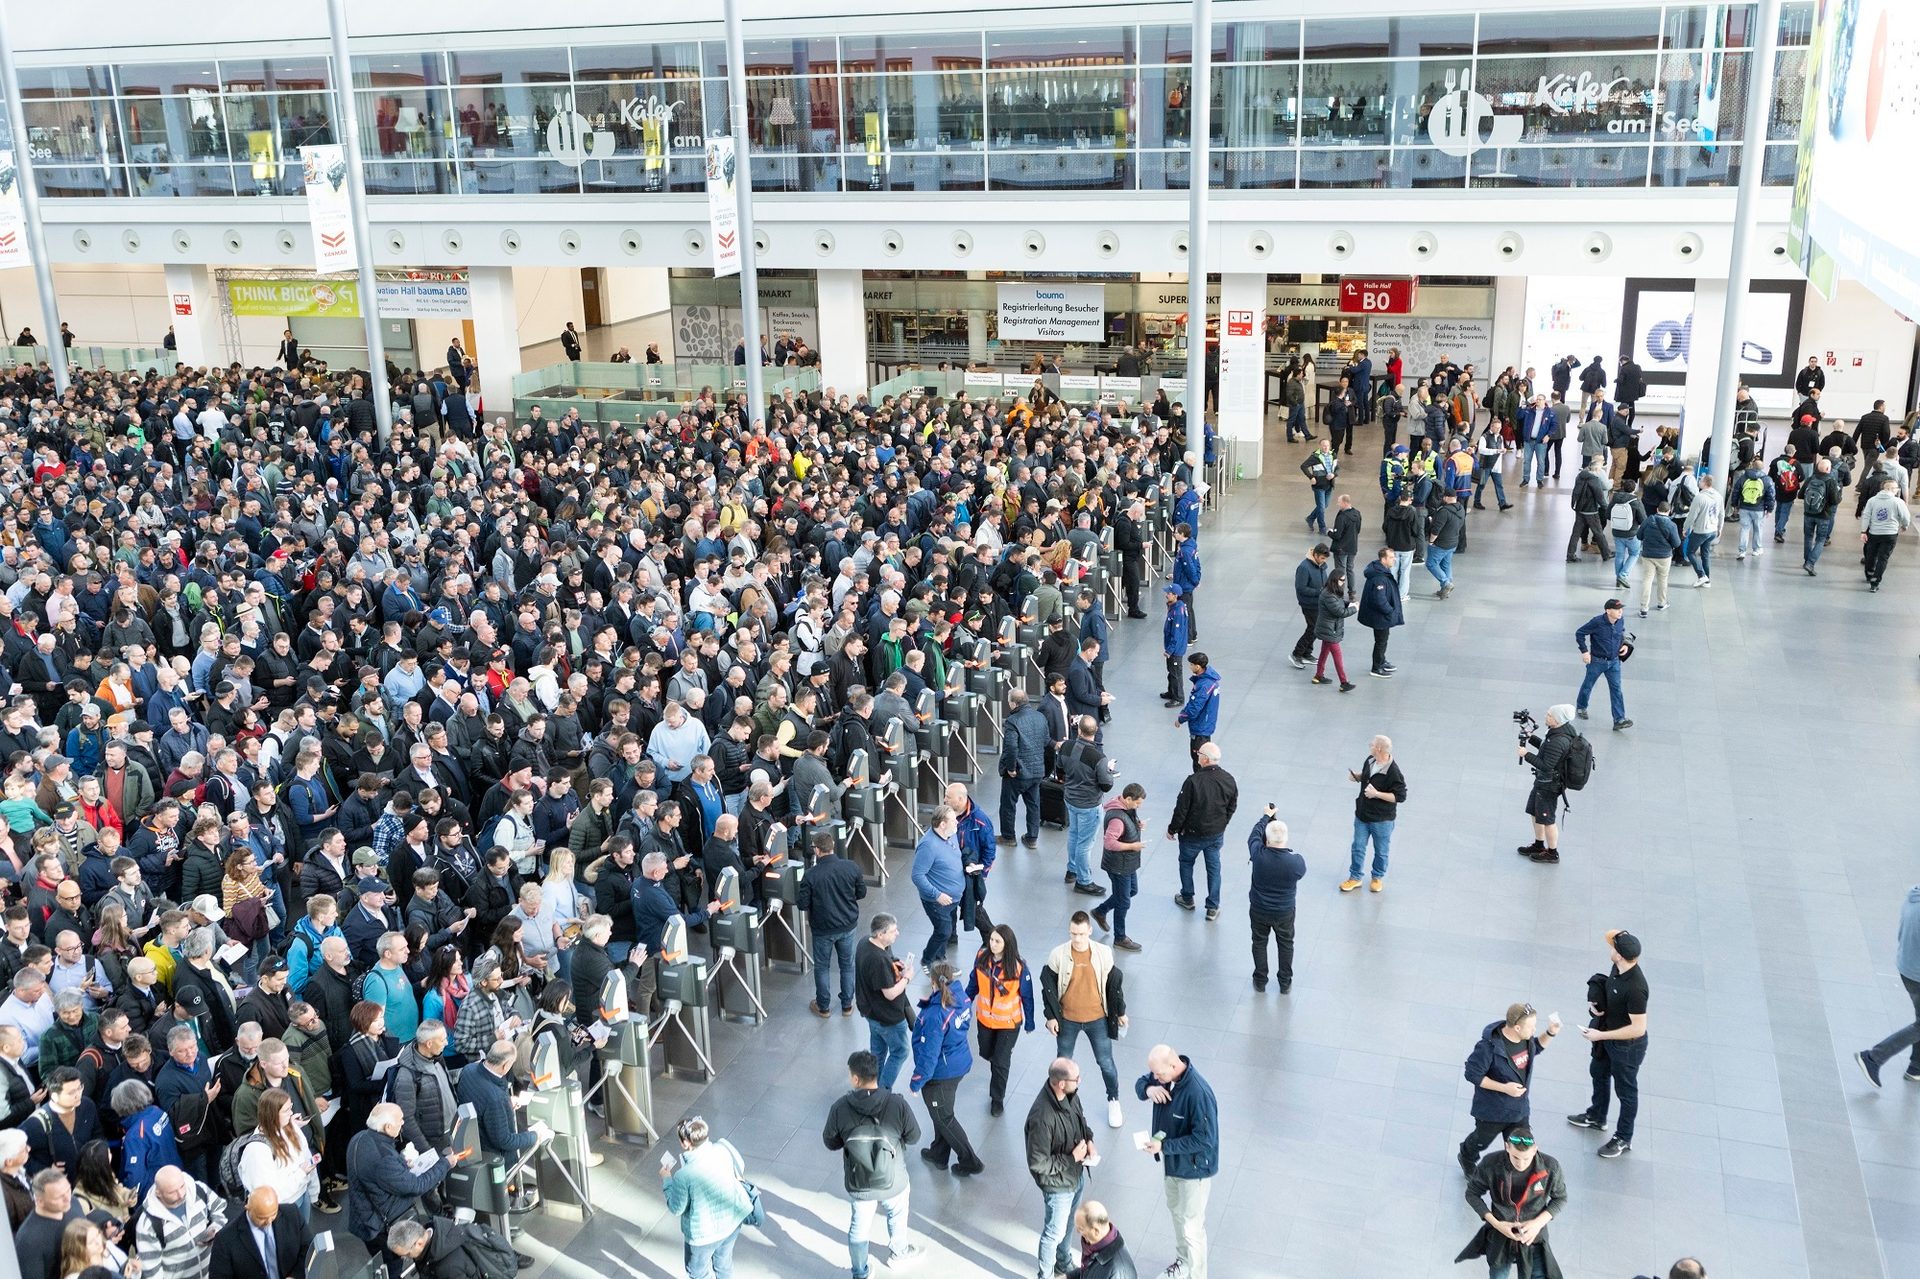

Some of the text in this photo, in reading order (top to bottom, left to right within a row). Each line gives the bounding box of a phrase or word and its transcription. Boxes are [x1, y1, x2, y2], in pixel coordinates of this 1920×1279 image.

[1535, 71, 1630, 115] Käfer
[620, 95, 686, 131] Käfer
[1607, 111, 1702, 134] am See
[674, 136, 701, 148] am
[28, 143, 52, 158] See
[234, 286, 309, 302] THINK BIG!
[377, 287, 399, 295] vation
[401, 286, 416, 295] Hall
[418, 287, 444, 296] bauma
[1036, 289, 1065, 300] bauma
[1002, 302, 1100, 313] Registrierleitung Besucher
[1003, 316, 1100, 328] Registration Management
[1398, 323, 1422, 331] Snacks,
[1037, 327, 1065, 336] Visitors
[1459, 333, 1488, 341] Souvenir,
